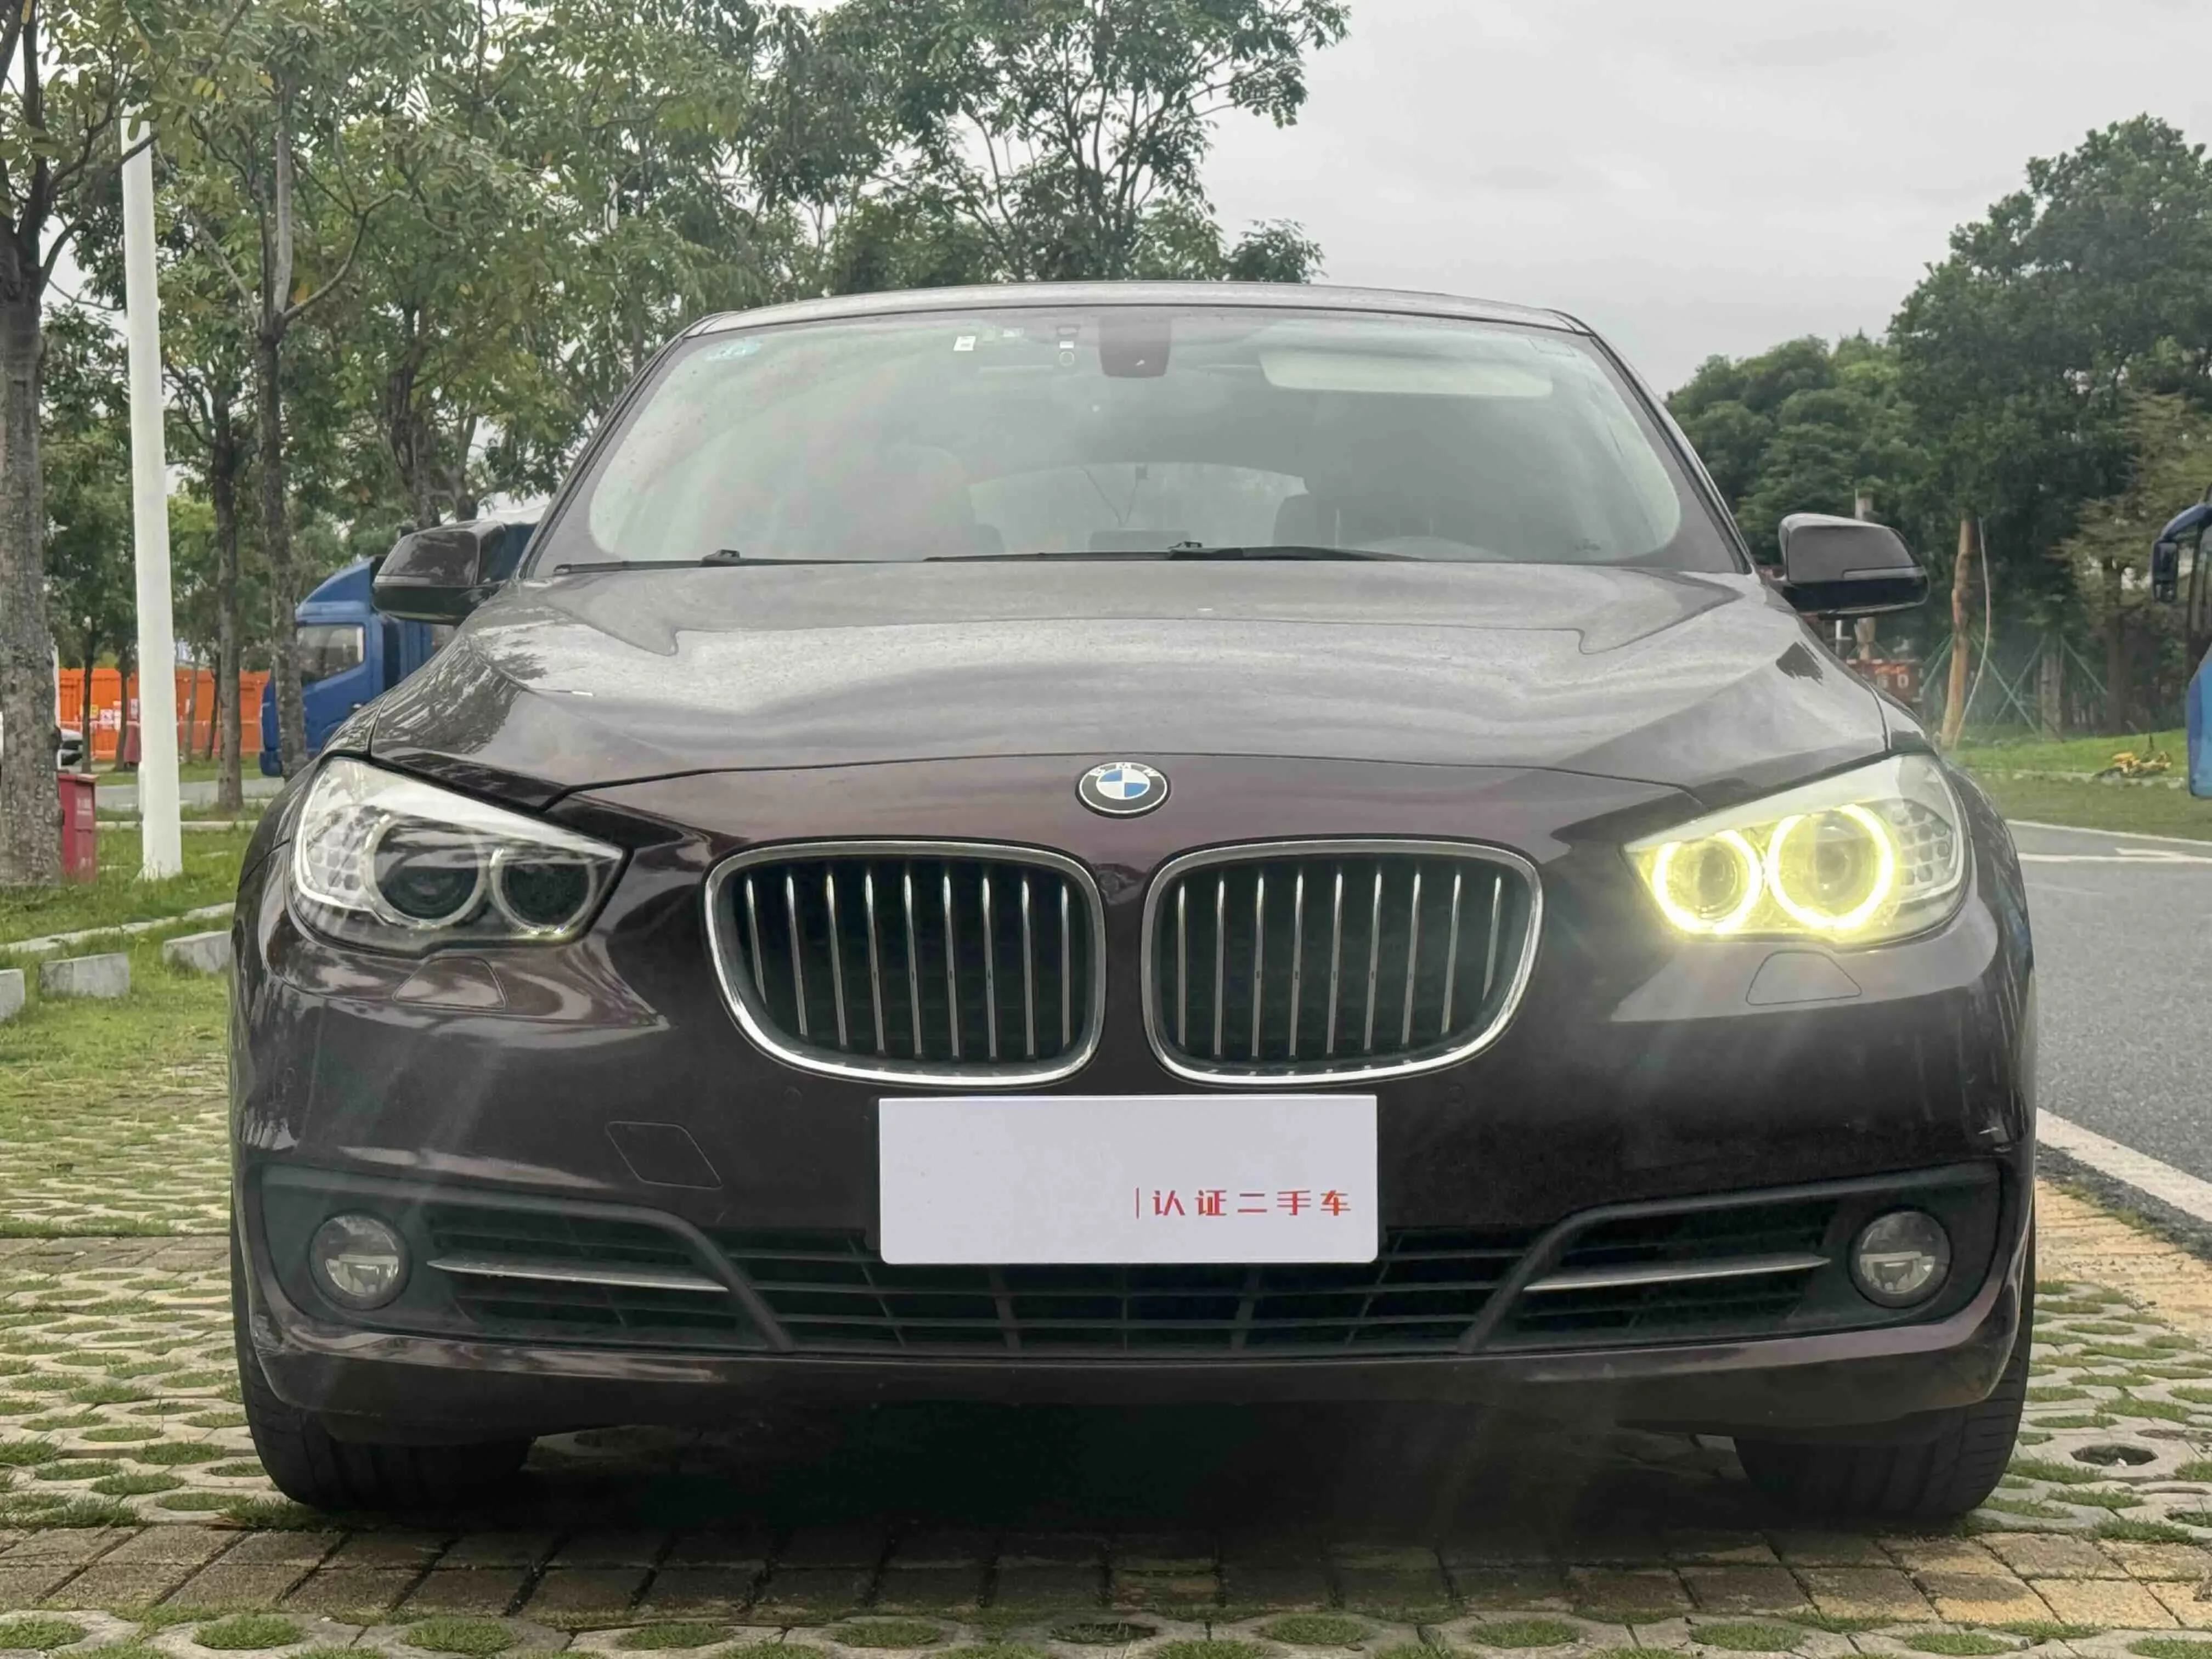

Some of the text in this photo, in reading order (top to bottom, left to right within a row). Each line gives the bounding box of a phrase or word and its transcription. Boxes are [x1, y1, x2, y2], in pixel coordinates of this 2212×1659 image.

[1088, 761, 1160, 777] BMW
[1152, 1189, 1351, 1216] 认证二手车
